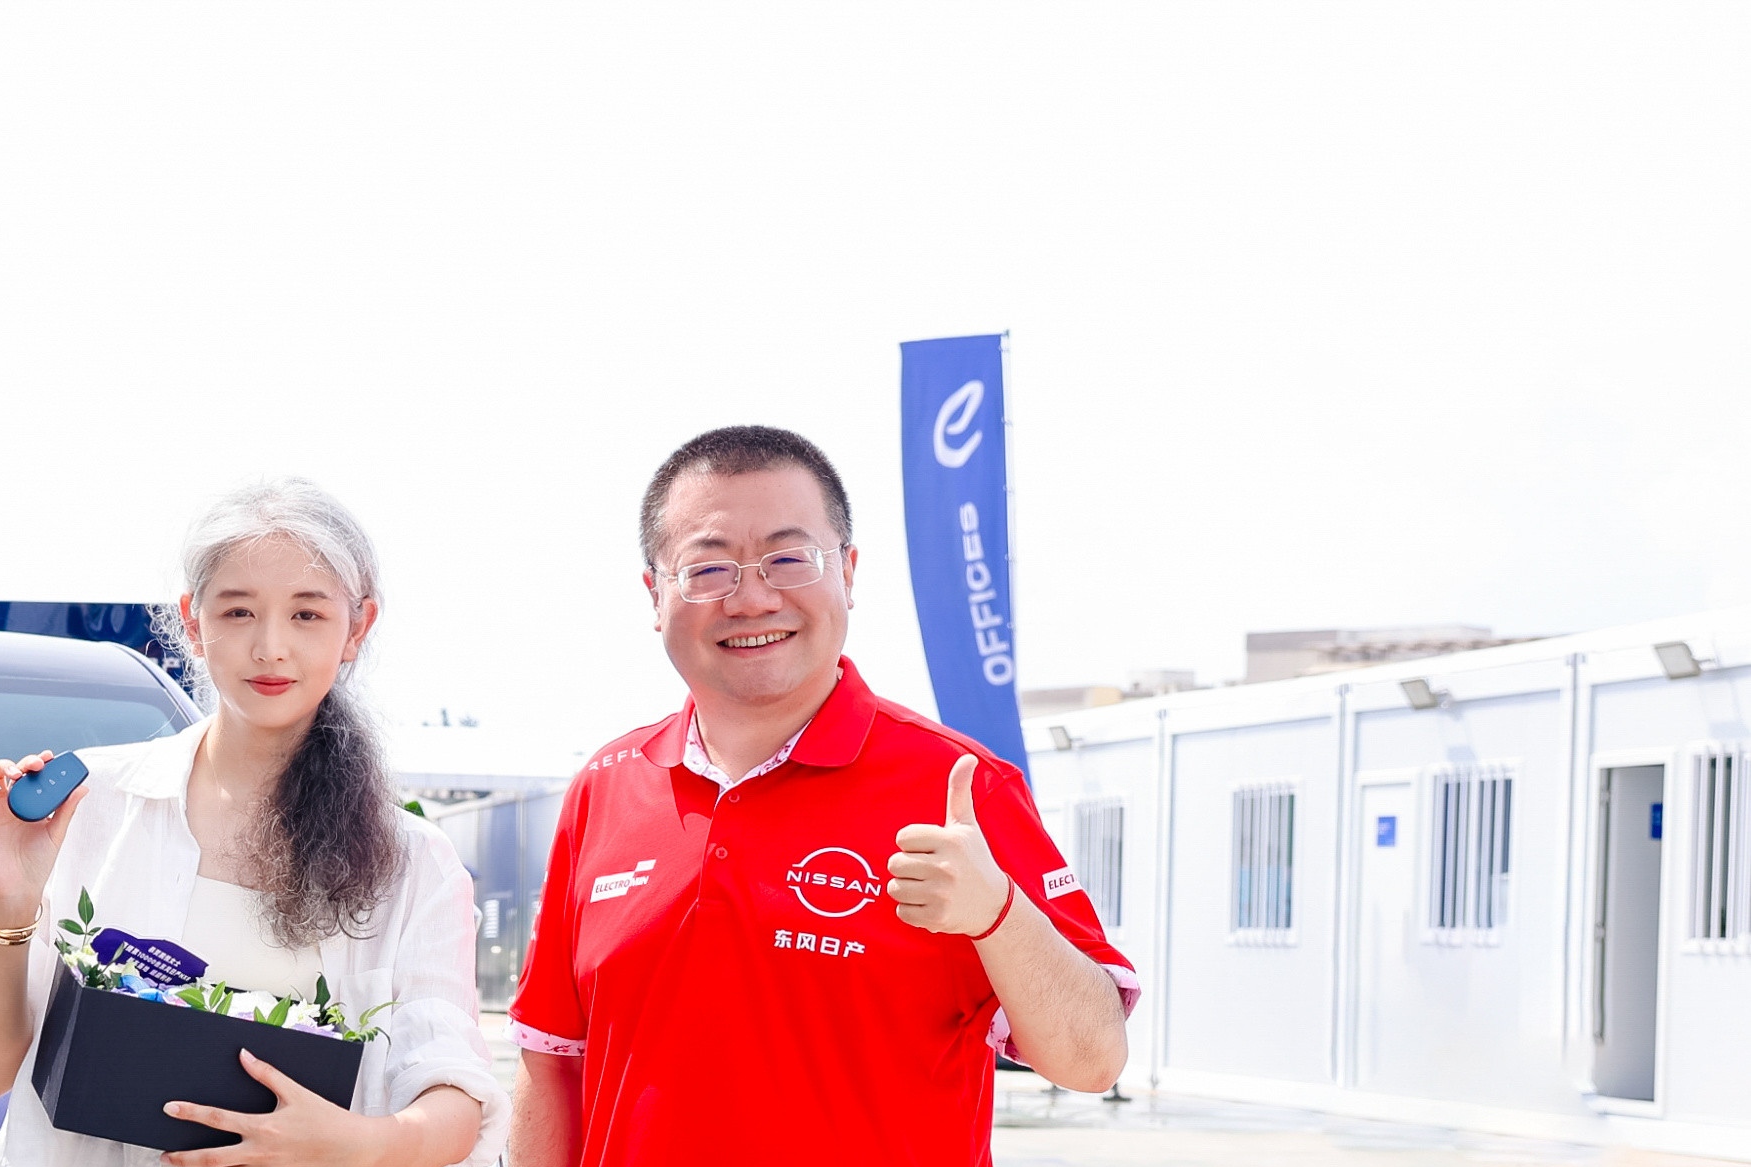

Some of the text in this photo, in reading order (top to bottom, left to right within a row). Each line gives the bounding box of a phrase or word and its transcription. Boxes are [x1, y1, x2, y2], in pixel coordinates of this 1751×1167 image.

[959, 501, 1014, 686] OFFICES
[786, 869, 882, 897] NISSAN
[773, 929, 866, 958] 东风日产
